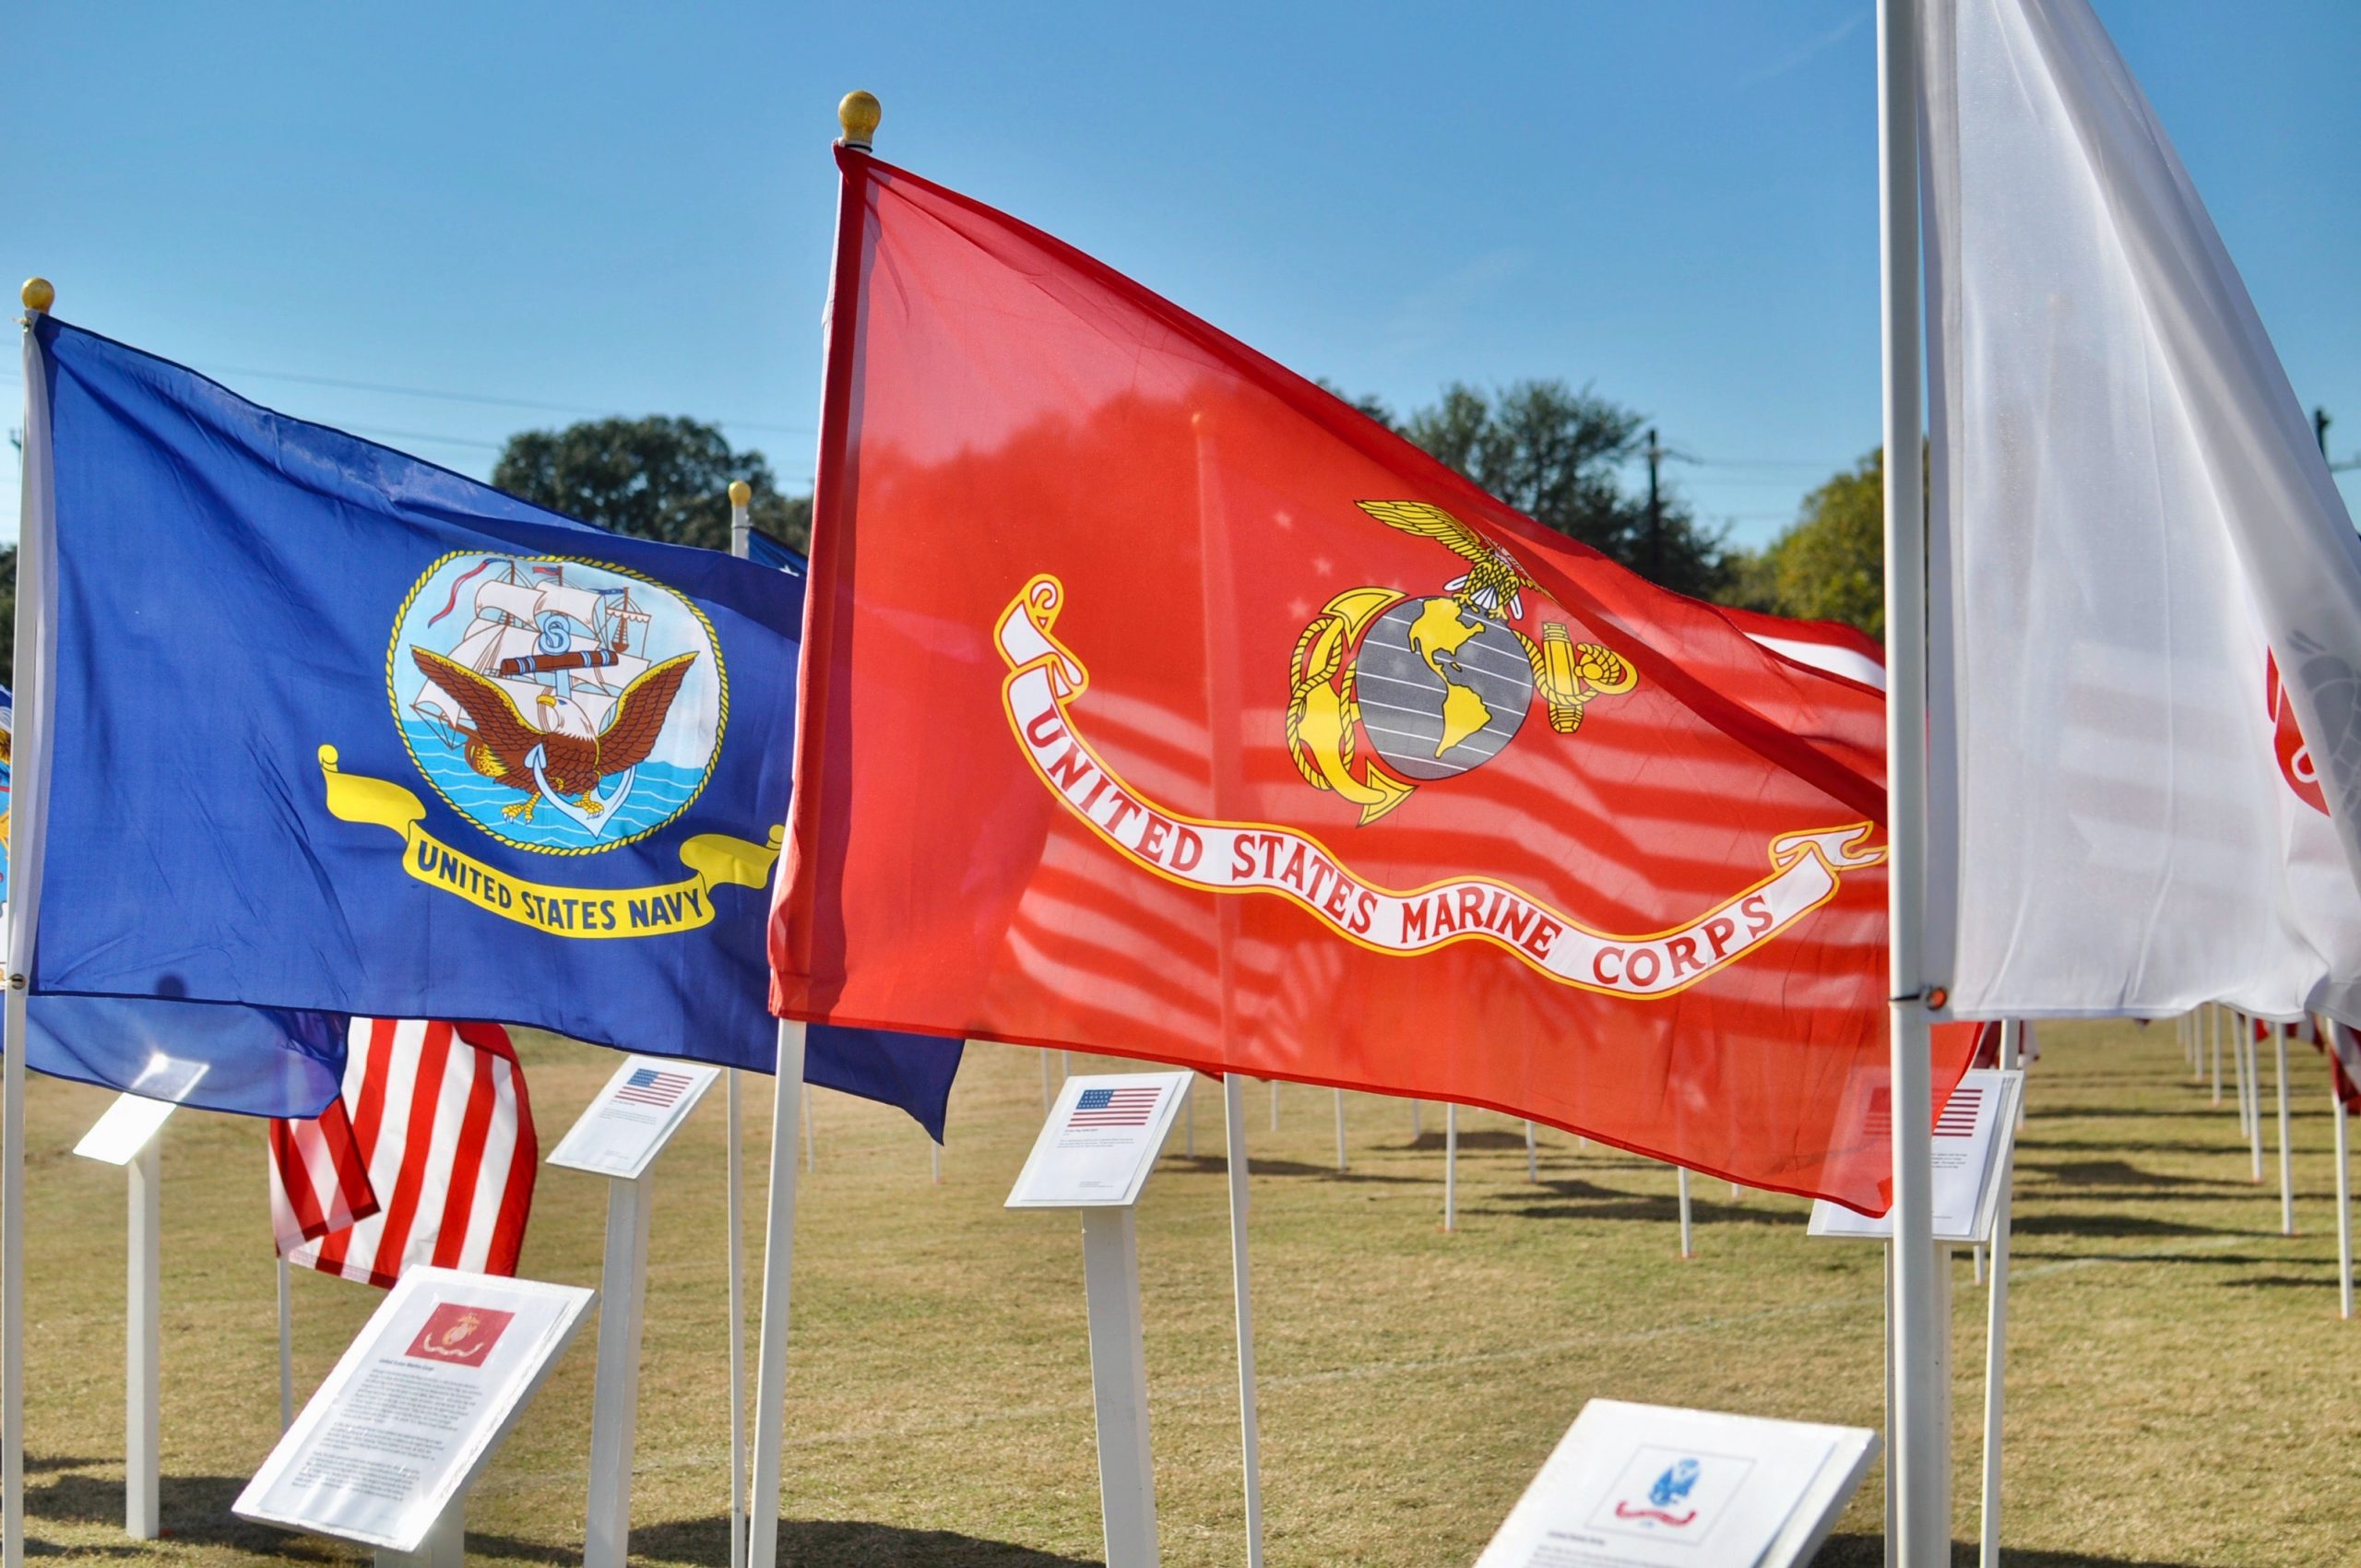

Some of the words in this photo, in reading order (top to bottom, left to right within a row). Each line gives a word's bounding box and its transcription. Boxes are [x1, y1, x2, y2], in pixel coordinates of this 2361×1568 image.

[417, 840, 513, 909] UNITED
[521, 891, 617, 931] STATES
[628, 887, 704, 929] NAVY
[1026, 703, 1204, 873] UNITED
[1232, 833, 1378, 934] STATES
[1400, 886, 1563, 961] MARINE
[1592, 895, 1774, 986] CORPS
